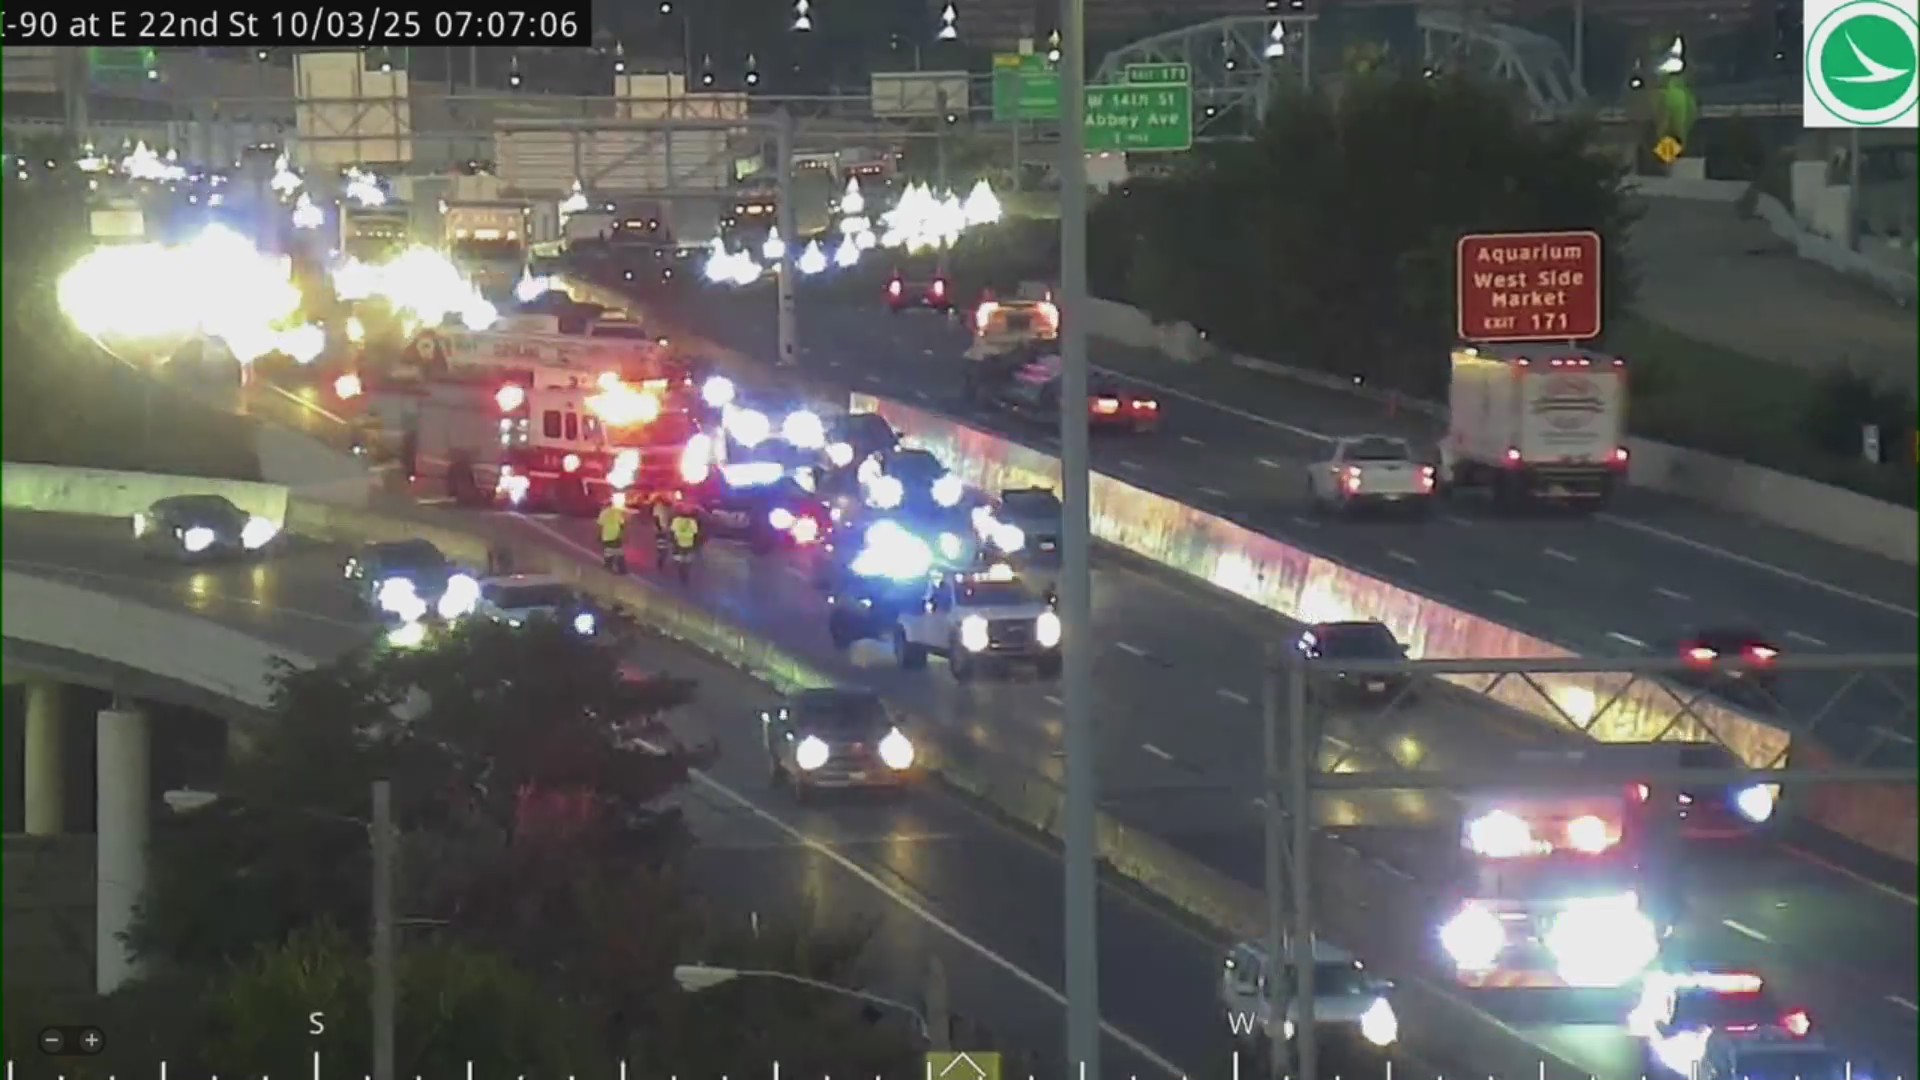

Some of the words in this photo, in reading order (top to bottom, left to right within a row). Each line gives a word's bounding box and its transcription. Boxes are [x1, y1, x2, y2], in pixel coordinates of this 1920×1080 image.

[1087, 93, 1104, 107] W
[1084, 113, 1139, 128] Abbey
[1147, 112, 1180, 126] Ave
[1477, 243, 1582, 265] Aquarium
[1473, 271, 1527, 289] West
[1537, 269, 1584, 287] Side
[1491, 290, 1566, 308] Market
[1483, 316, 1516, 330] EXIT
[1531, 312, 1568, 330] 171
